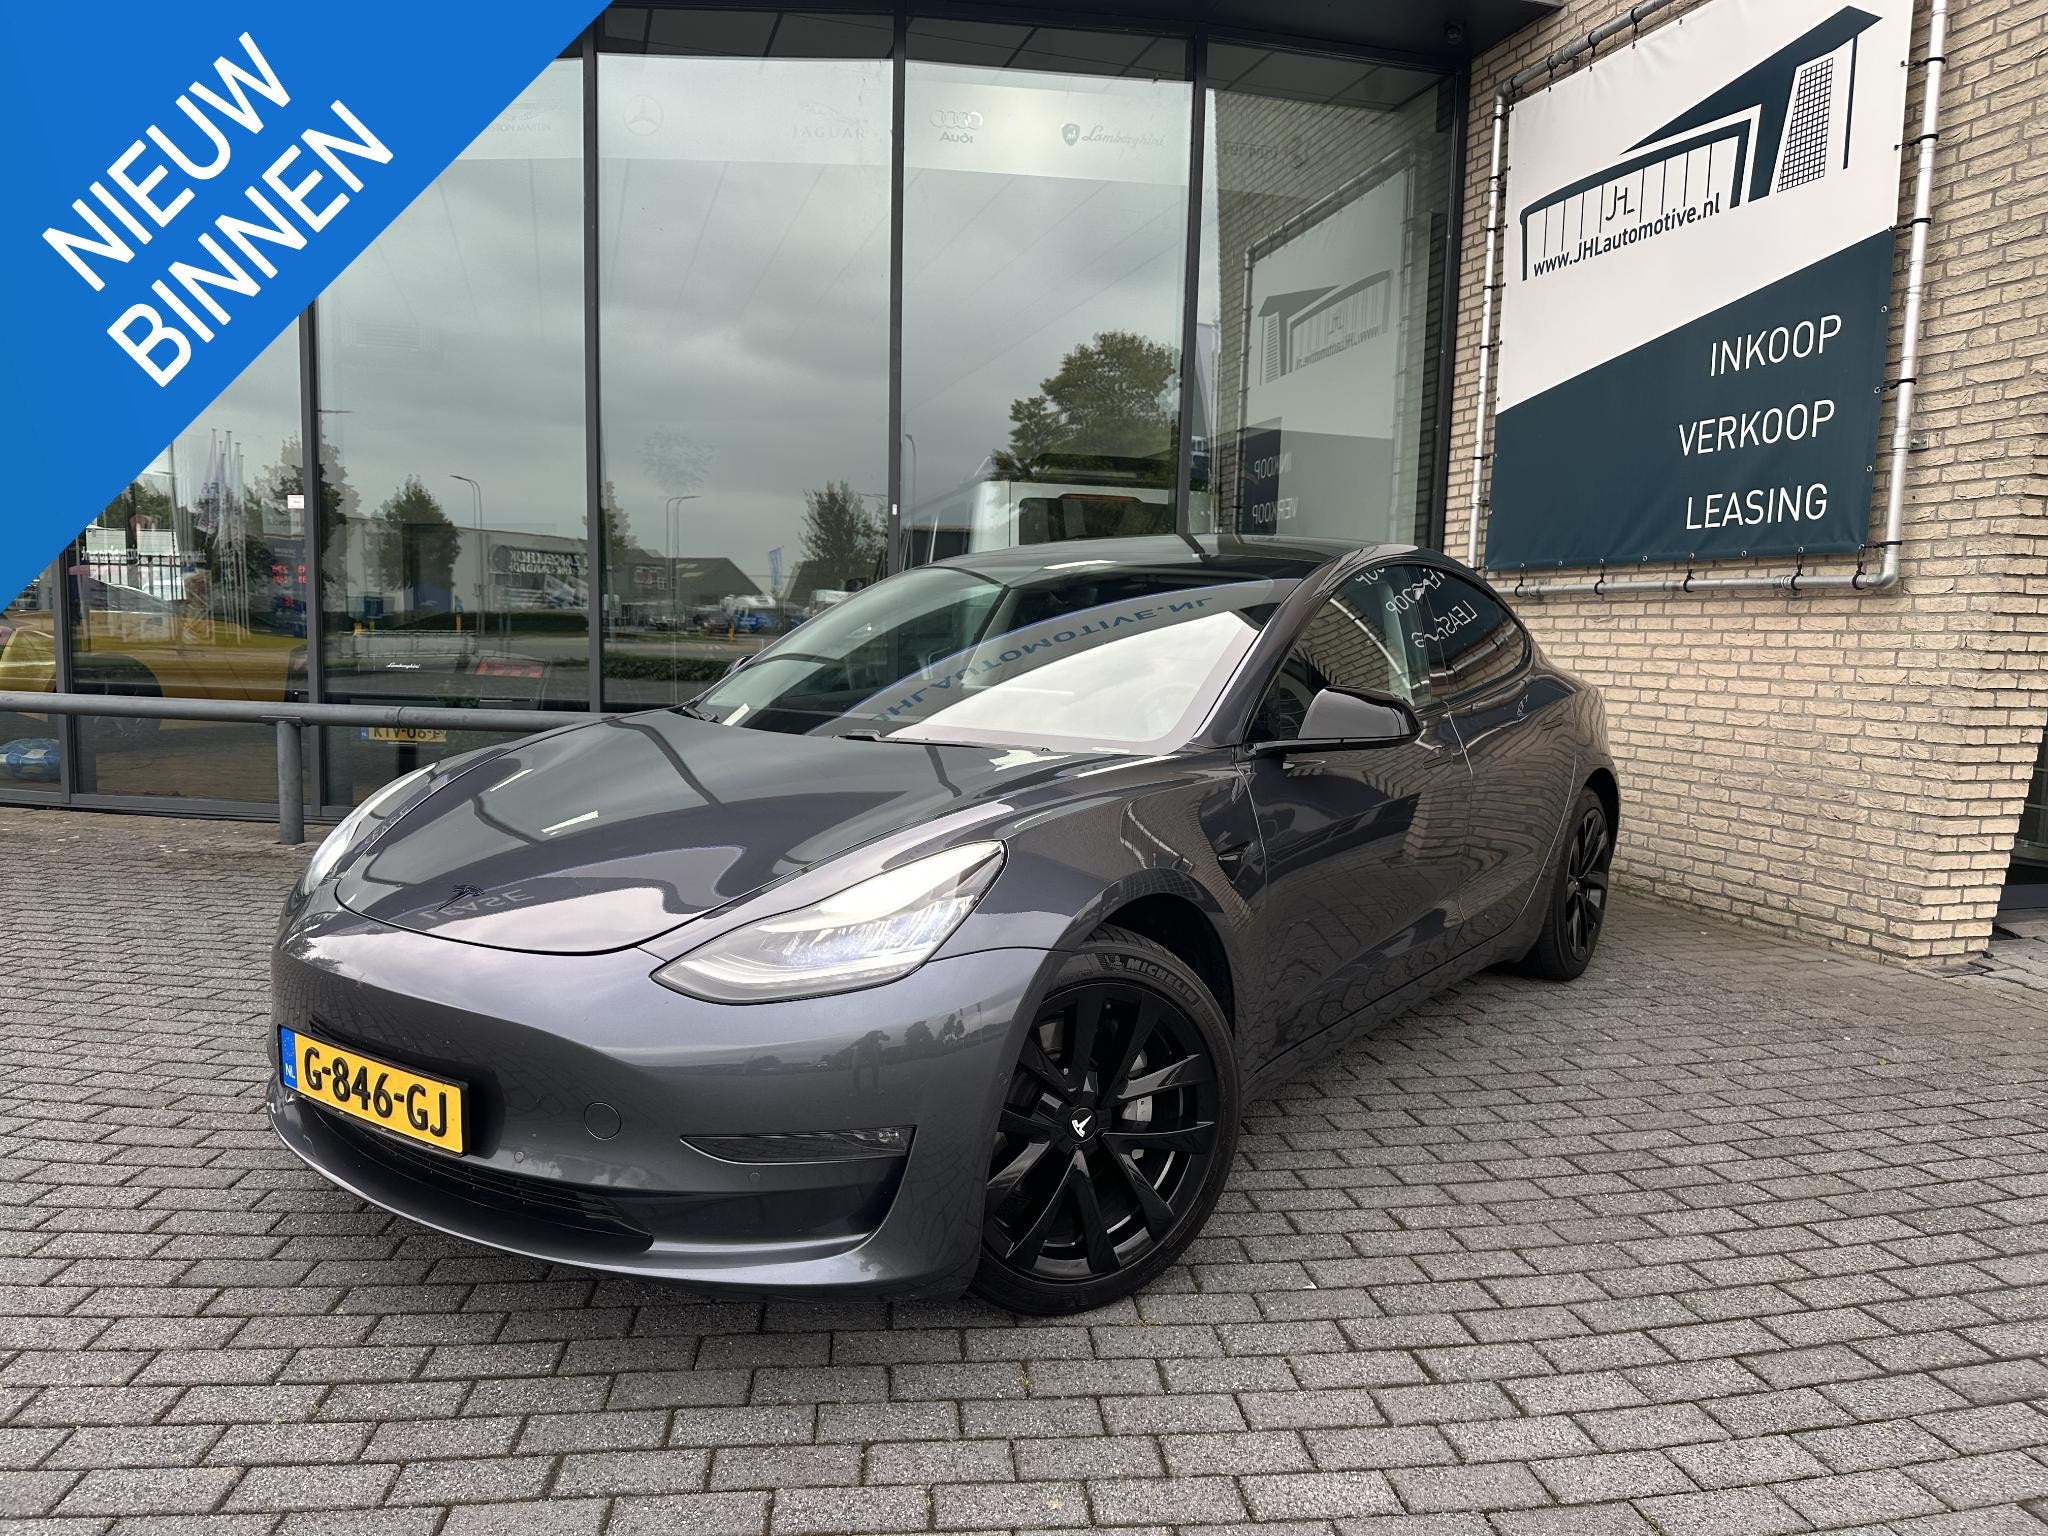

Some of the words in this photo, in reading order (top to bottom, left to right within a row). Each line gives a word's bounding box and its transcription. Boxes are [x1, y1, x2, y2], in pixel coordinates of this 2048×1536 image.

[791, 125, 865, 139] JAGUAR
[1081, 124, 1166, 148] Lamborghini
[1605, 185, 1635, 222] JHL
[1533, 192, 1720, 277] www.JHLautomotive.nl
[1710, 314, 1842, 377] INKOOP
[1678, 399, 1835, 457] VERKOOP
[1685, 482, 1828, 530] LEASING
[1126, 958, 1201, 1006] MICHELIN
[285, 1063, 295, 1079] NL
[304, 1046, 448, 1138] G-846-GJ
